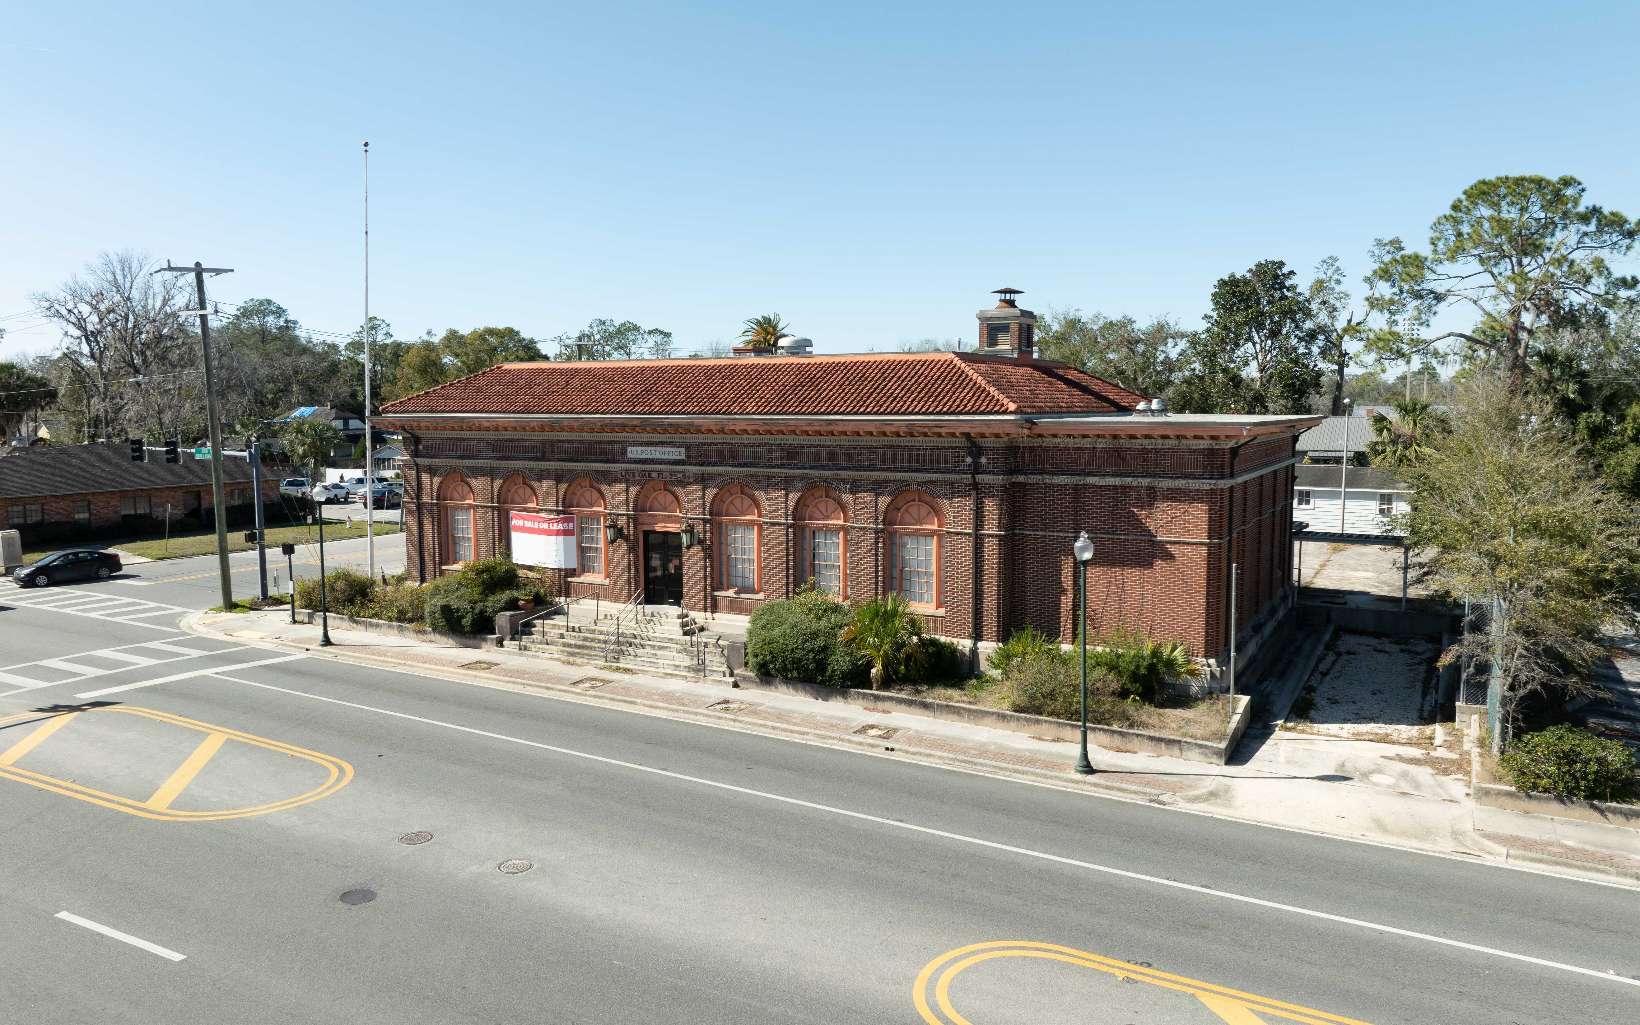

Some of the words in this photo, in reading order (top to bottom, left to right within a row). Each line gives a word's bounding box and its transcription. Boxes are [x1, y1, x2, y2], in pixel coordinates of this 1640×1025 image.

[512, 519, 523, 527] FOR
[524, 519, 538, 528] SALE
[538, 521, 548, 529] OR
